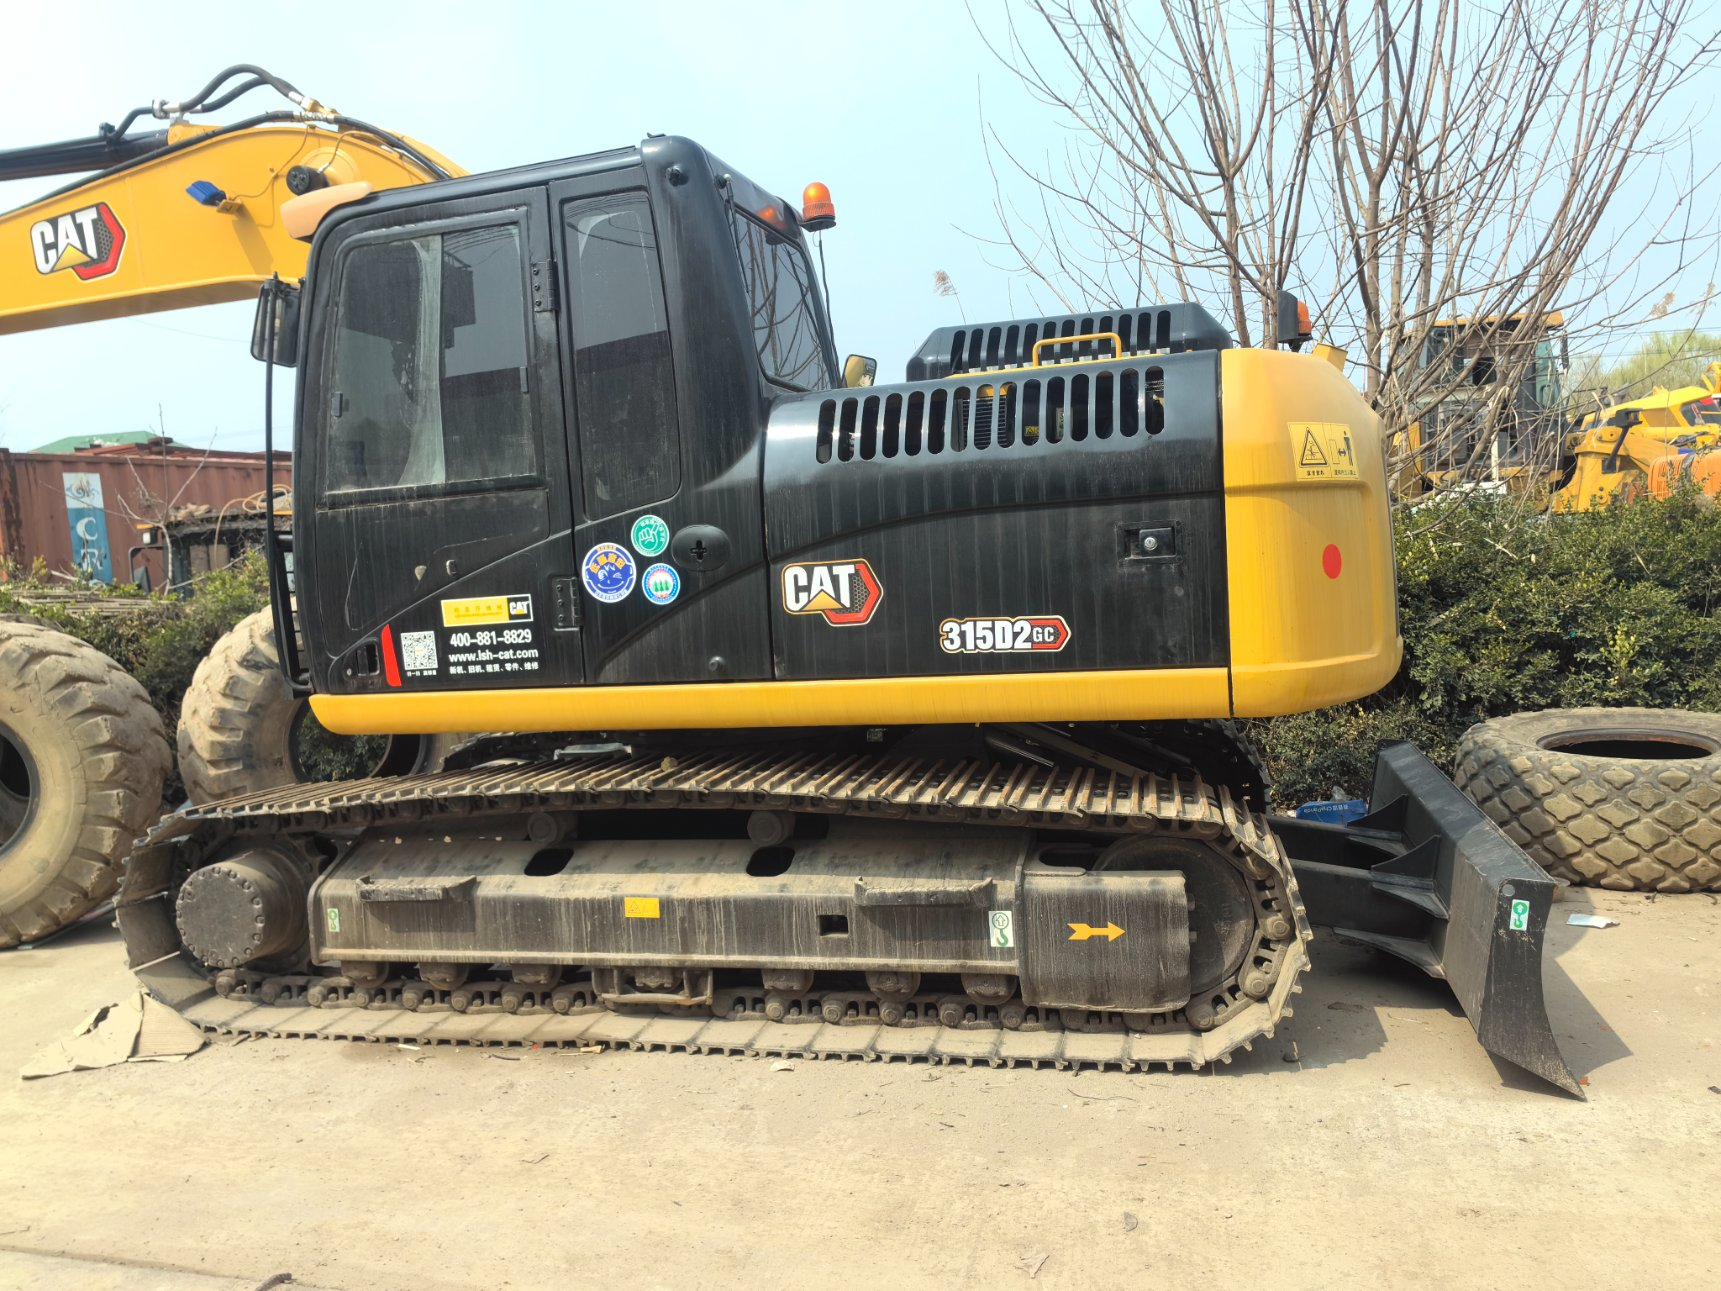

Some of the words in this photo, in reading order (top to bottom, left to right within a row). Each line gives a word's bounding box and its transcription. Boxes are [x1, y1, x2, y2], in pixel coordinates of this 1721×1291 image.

[31, 206, 98, 275] CAT
[784, 564, 855, 612] CAT
[509, 601, 530, 616] CAT
[449, 629, 532, 647] 400-881-8829
[942, 619, 1032, 651] 315D2
[1032, 626, 1055, 643] GC
[448, 648, 539, 663] www.lsh-cat.com
